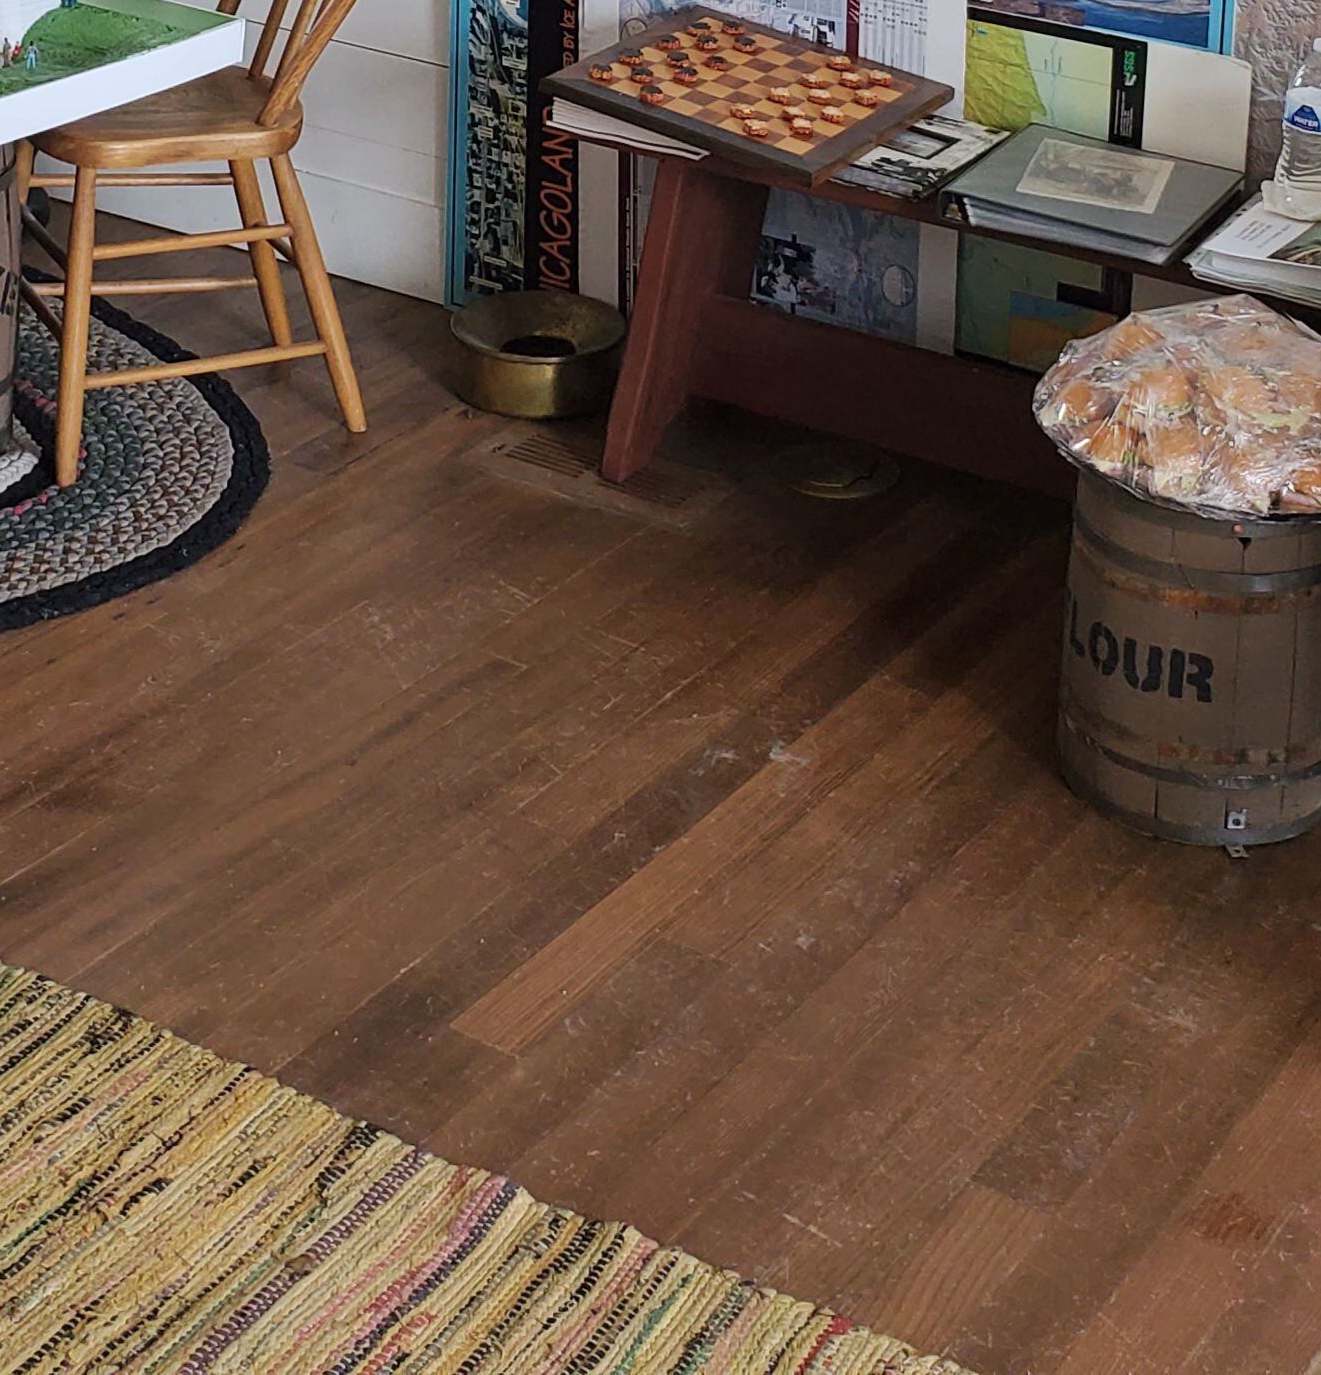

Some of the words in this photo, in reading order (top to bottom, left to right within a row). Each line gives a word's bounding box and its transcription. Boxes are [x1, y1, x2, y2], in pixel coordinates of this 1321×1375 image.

[563, 30, 575, 51] BY
[1293, 115, 1319, 128] WATER
[1069, 598, 1214, 703] LOUR
